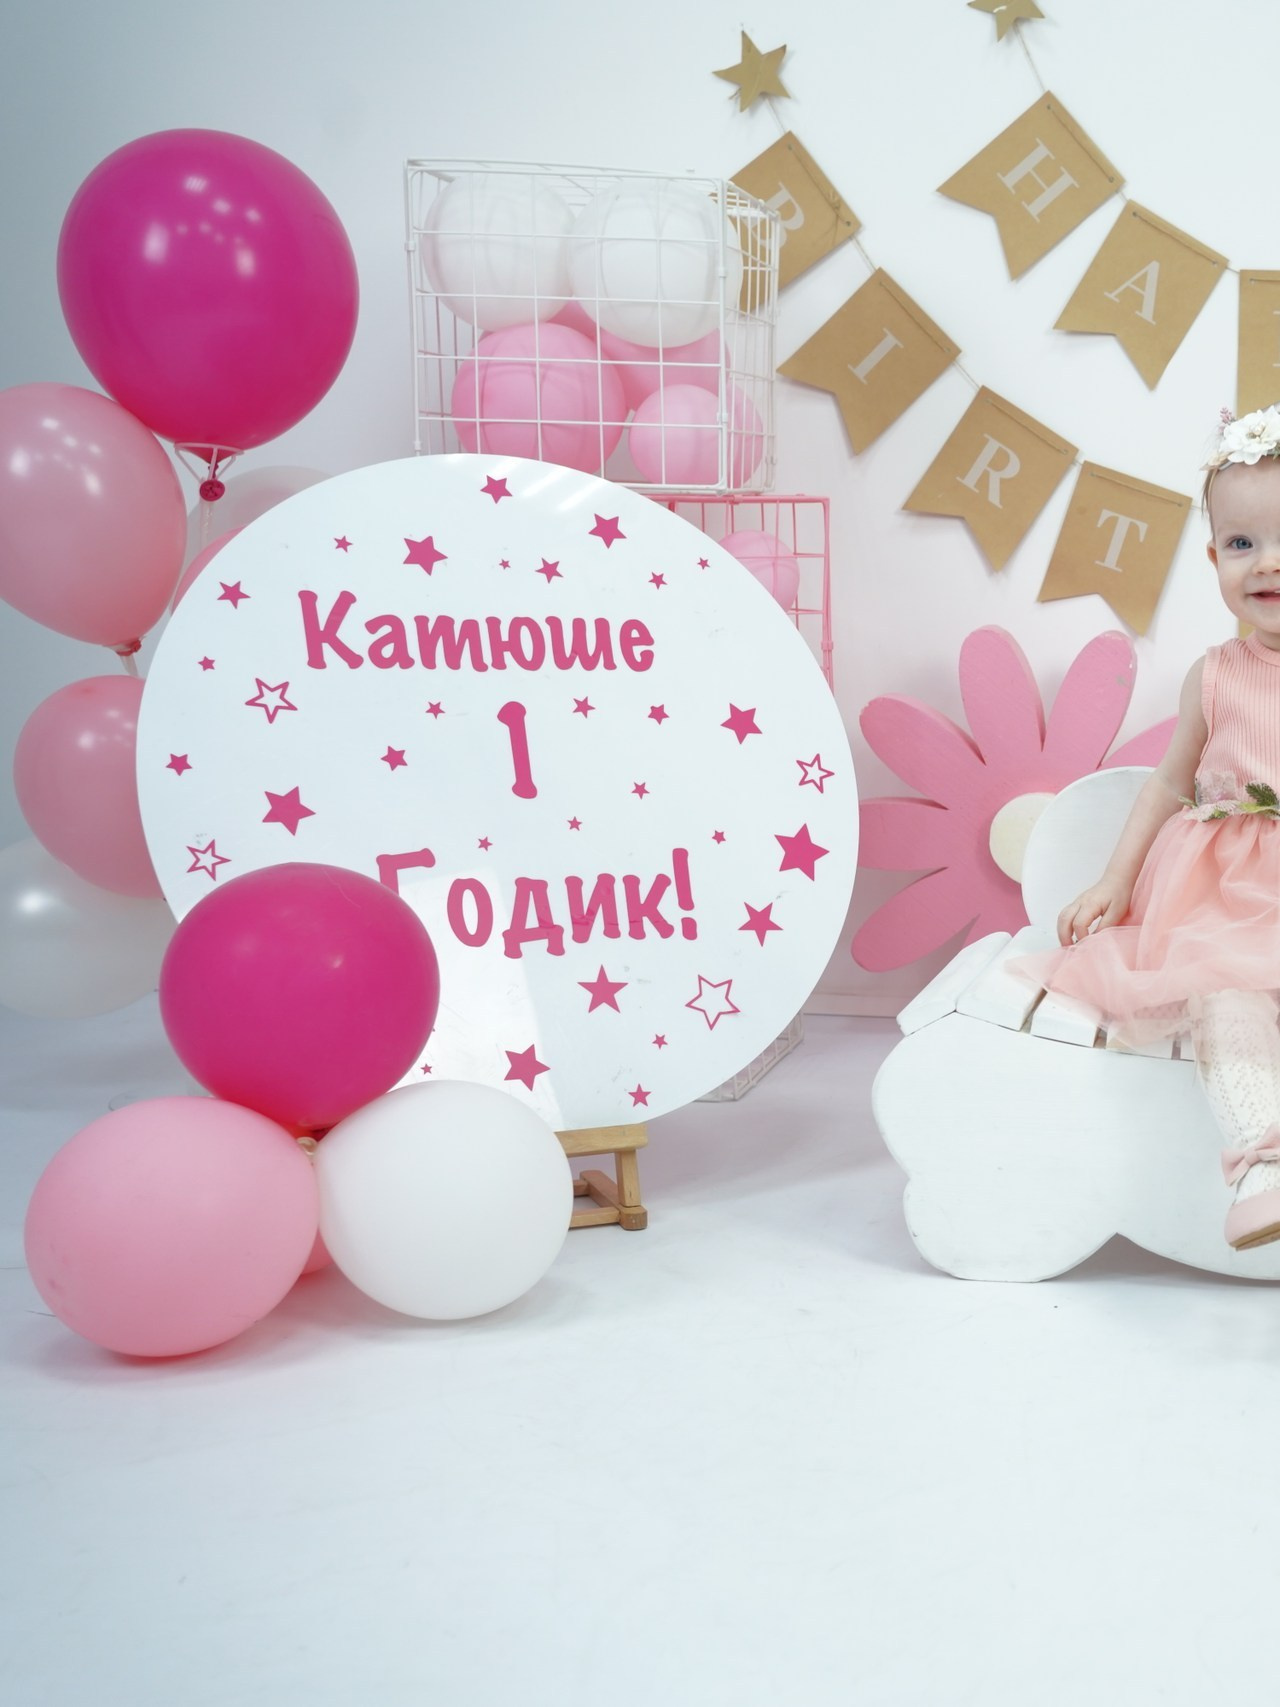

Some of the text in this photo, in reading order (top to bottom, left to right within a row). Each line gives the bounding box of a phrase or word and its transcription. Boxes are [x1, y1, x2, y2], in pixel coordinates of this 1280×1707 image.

[298, 590, 655, 673] Катюше
[497, 701, 538, 800] 1
[376, 848, 698, 960] Годик!
